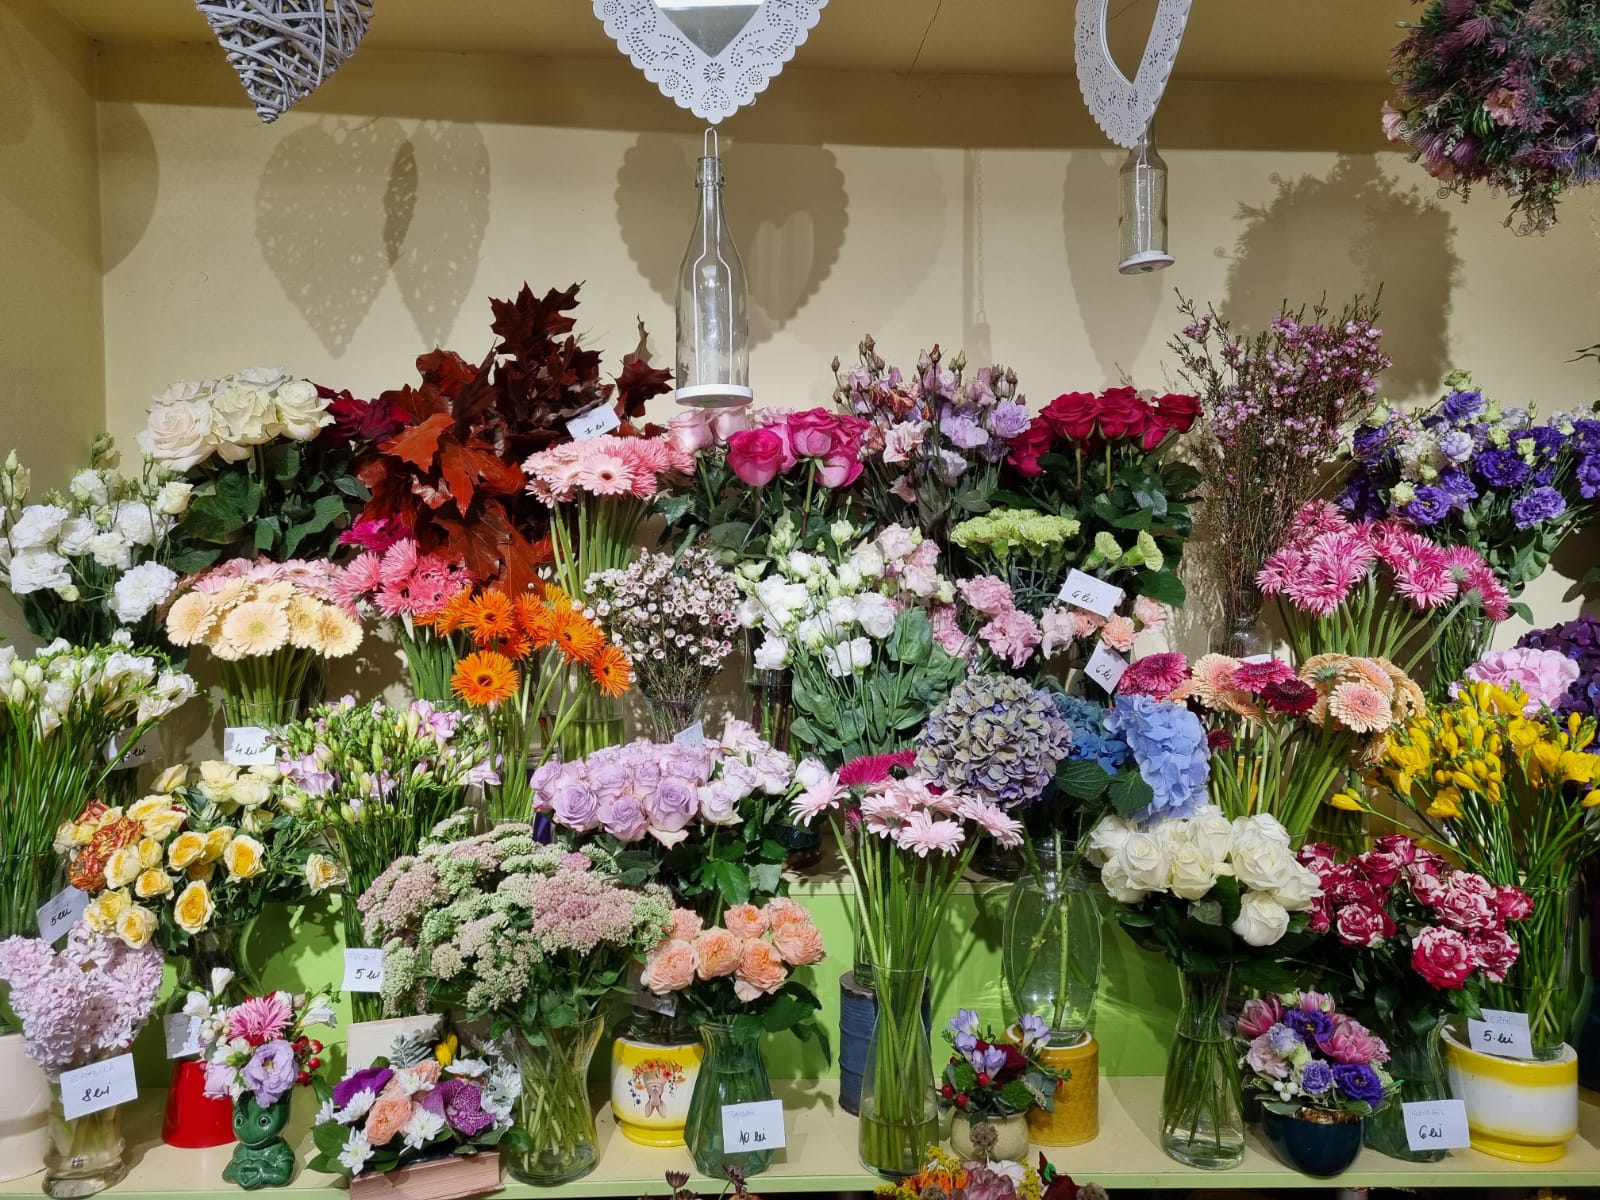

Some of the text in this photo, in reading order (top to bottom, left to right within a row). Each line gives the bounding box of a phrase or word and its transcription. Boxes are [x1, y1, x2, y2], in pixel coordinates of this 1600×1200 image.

[49, 915, 57, 926] 5
[56, 904, 73, 921] lei
[354, 968, 367, 980] 5
[1497, 1033, 1514, 1044] lei
[739, 1127, 767, 1145] 10 lei
[1418, 1123, 1442, 1140] 6 lei
